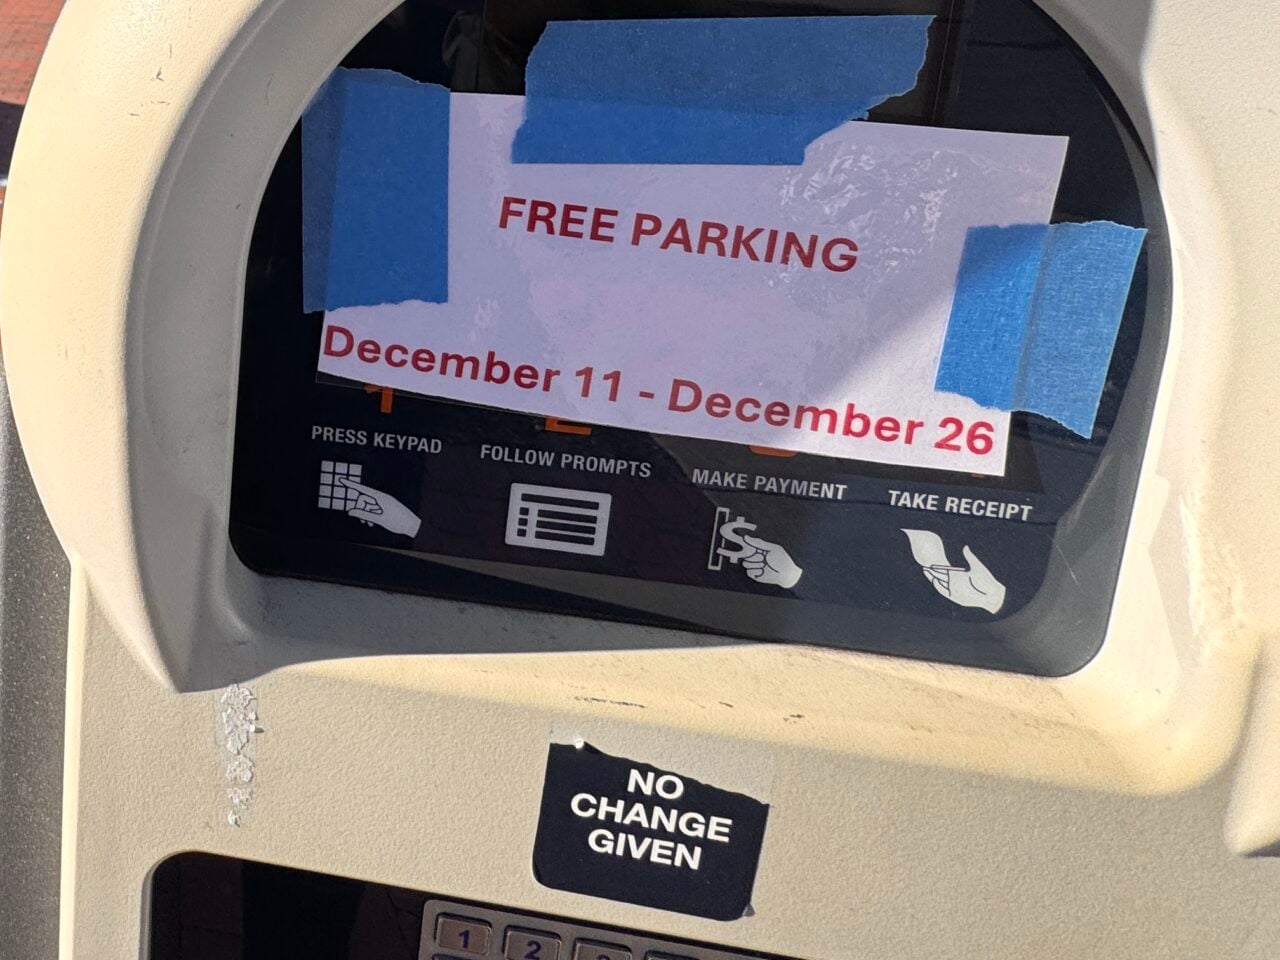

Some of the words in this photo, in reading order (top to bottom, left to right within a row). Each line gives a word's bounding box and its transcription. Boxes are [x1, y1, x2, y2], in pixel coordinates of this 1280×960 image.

[498, 196, 619, 243] FREE
[631, 213, 859, 273] PARKING
[322, 324, 561, 392] December
[575, 366, 622, 402] 11
[638, 389, 656, 400] -
[667, 378, 925, 445] December
[933, 417, 996, 457] 26
[311, 425, 368, 446] PRESS
[373, 432, 443, 454] KEYPAD
[480, 444, 556, 467] FOLLOW
[560, 453, 653, 479] PROMPTS
[691, 468, 748, 490] MAKE
[754, 475, 848, 500] PAYMENT
[888, 490, 939, 512] TAKE
[945, 497, 1034, 522] RECEIPT
[627, 768, 685, 800] NO
[570, 792, 734, 843] CHANGE
[587, 828, 703, 870] GIVEN
[458, 929, 471, 949] 1
[524, 940, 543, 960] 2
